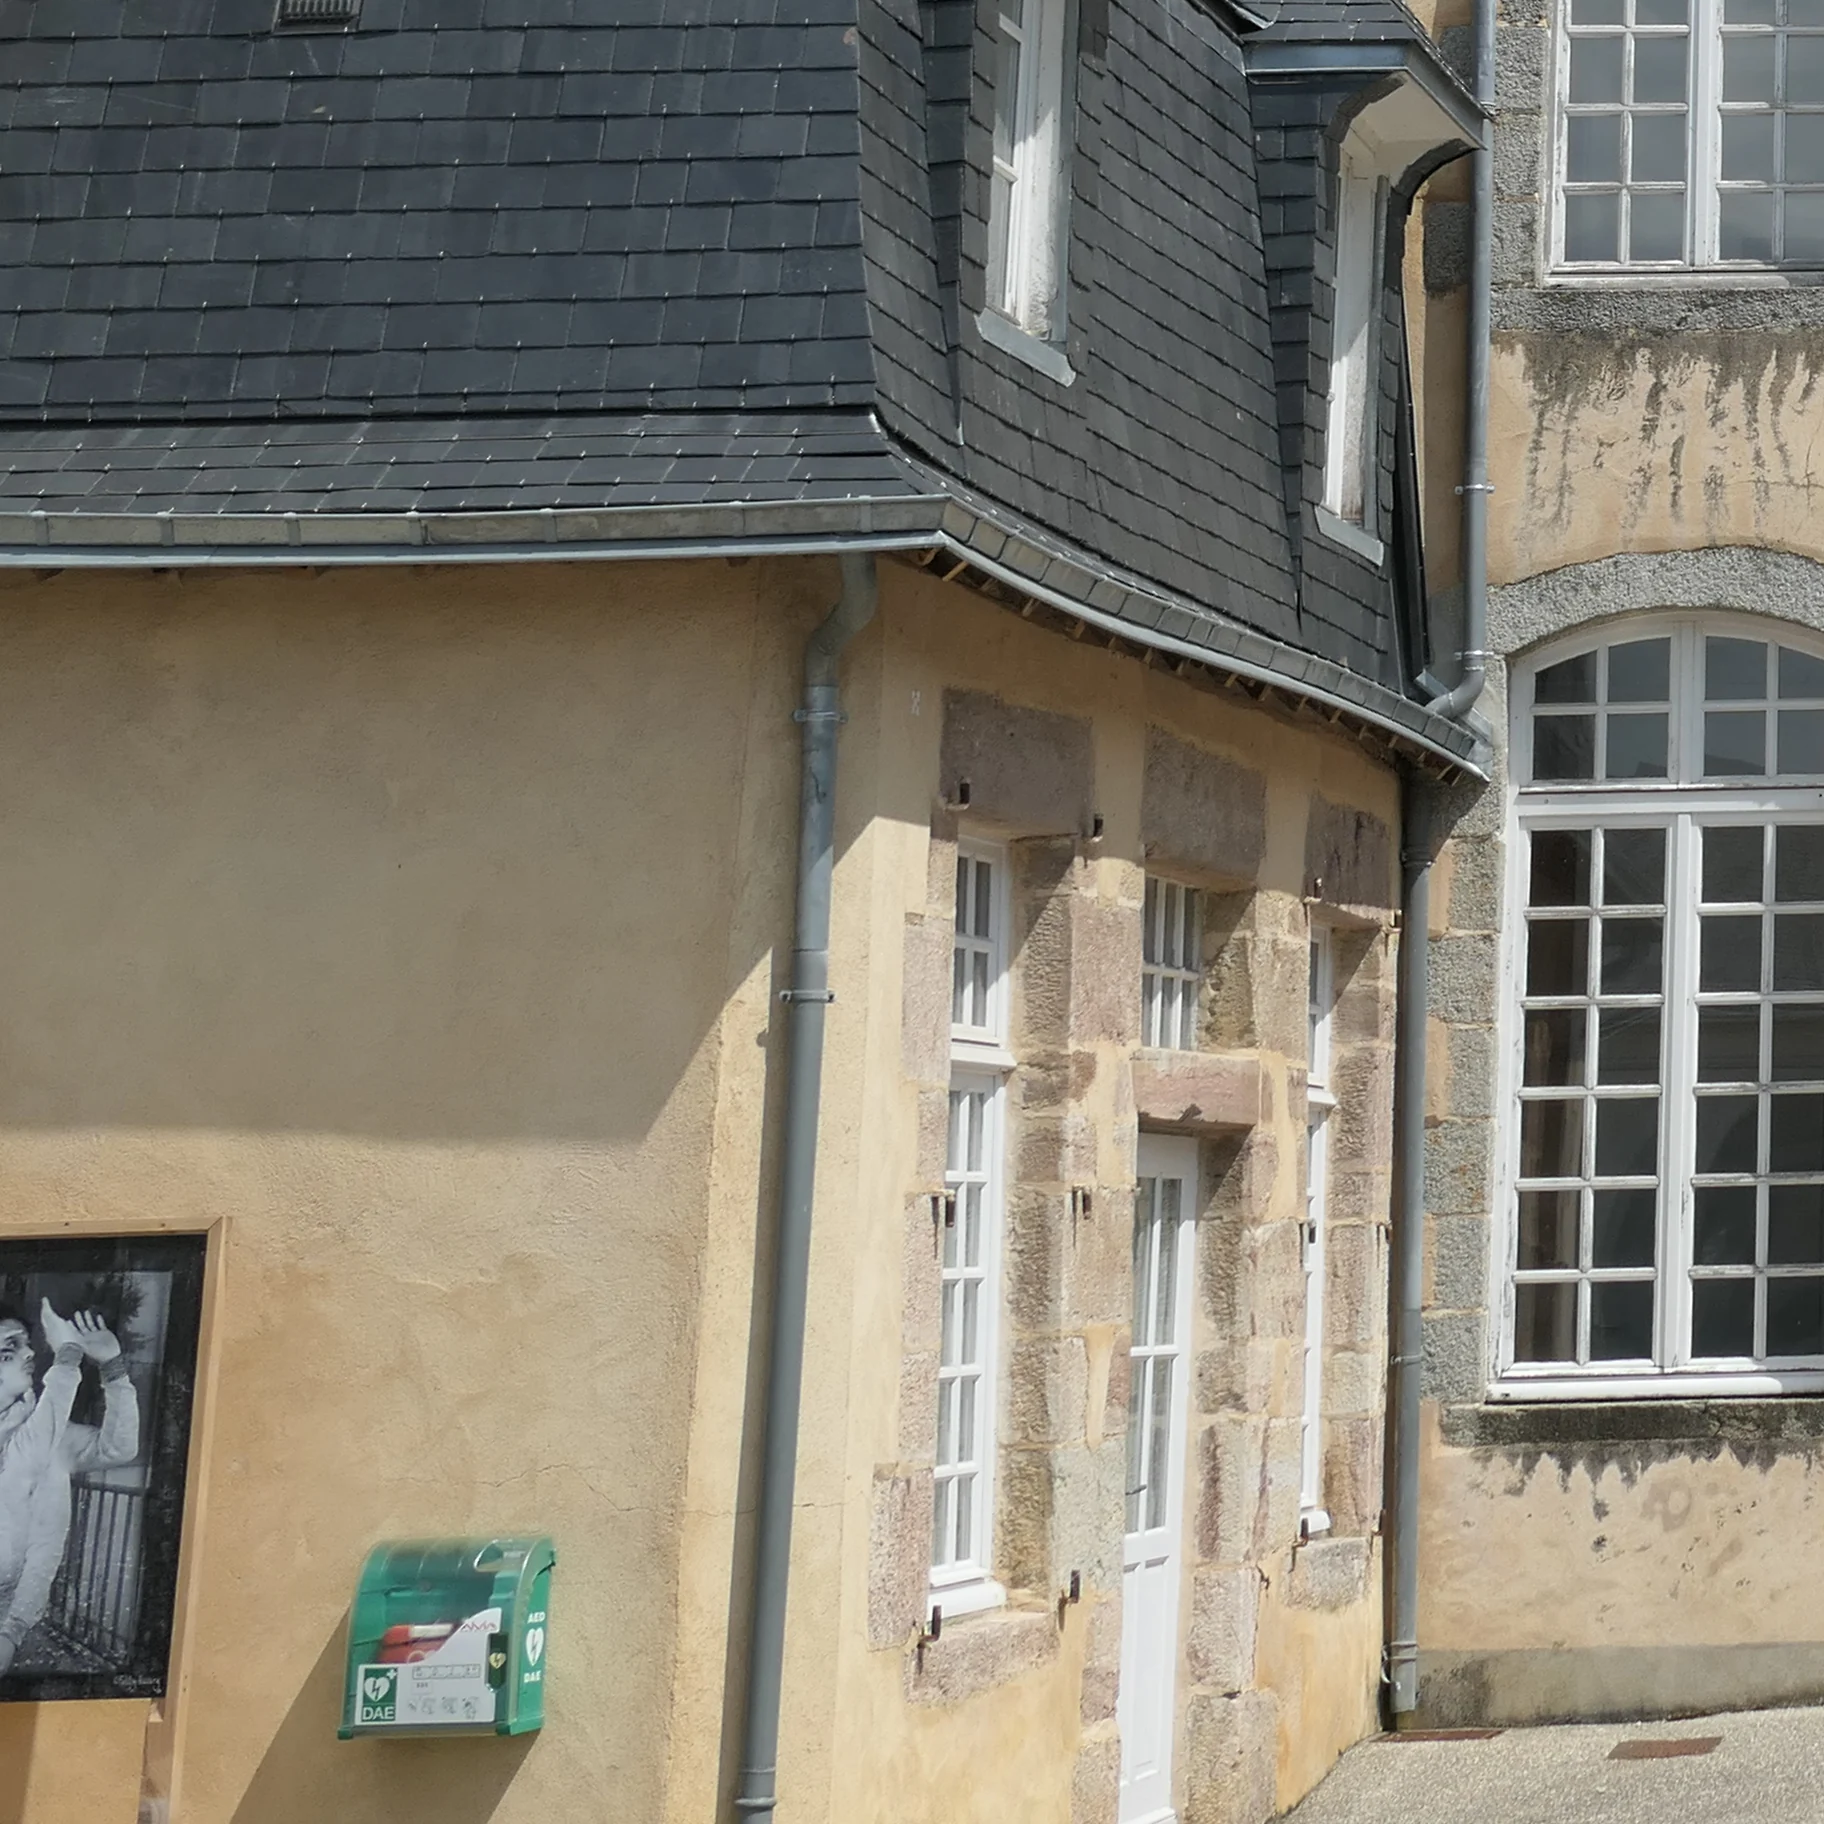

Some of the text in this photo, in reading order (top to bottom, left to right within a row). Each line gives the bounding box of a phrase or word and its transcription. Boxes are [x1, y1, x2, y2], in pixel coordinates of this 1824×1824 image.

[527, 1611, 546, 1624] AED
[523, 1670, 542, 1683] DAE
[362, 1706, 395, 1720] DAE
